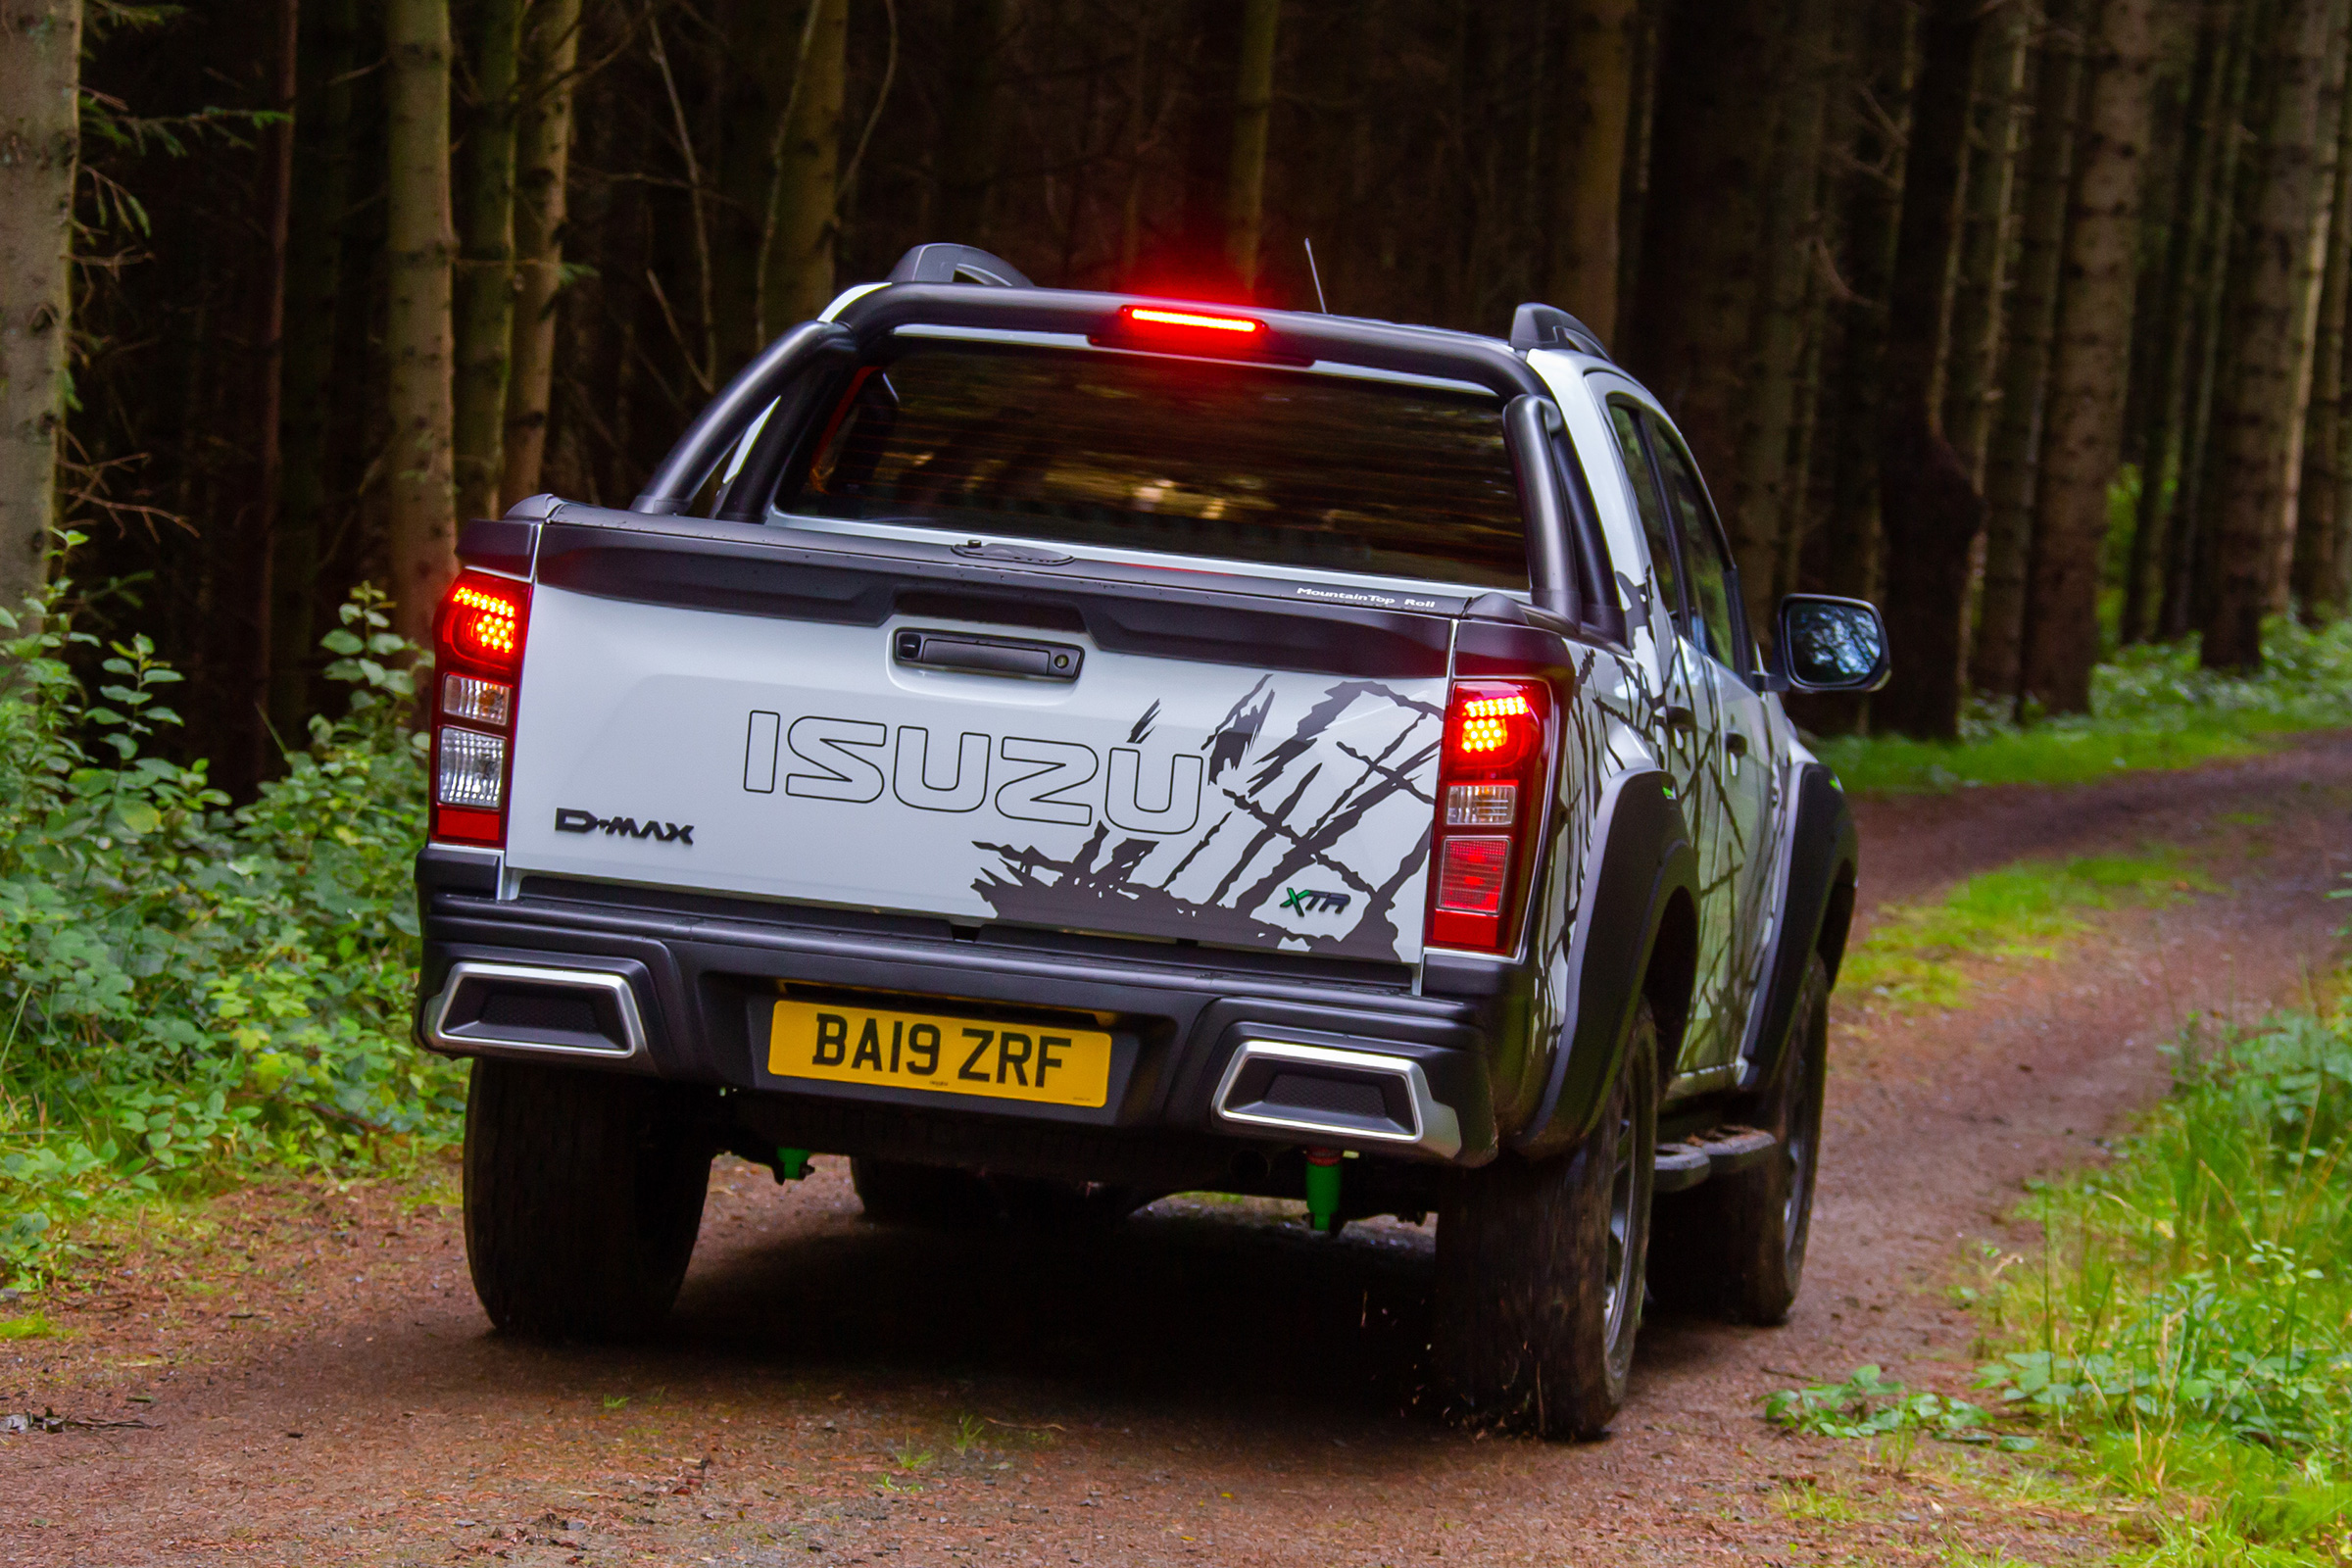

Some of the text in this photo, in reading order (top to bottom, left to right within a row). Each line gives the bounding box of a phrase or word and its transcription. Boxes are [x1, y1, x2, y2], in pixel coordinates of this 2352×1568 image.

[1297, 587, 1436, 609] MountainTop Roll
[744, 710, 1204, 835] ISUZU
[1280, 887, 1351, 917] XTR
[811, 1012, 1072, 1089] BA19 ZRF
